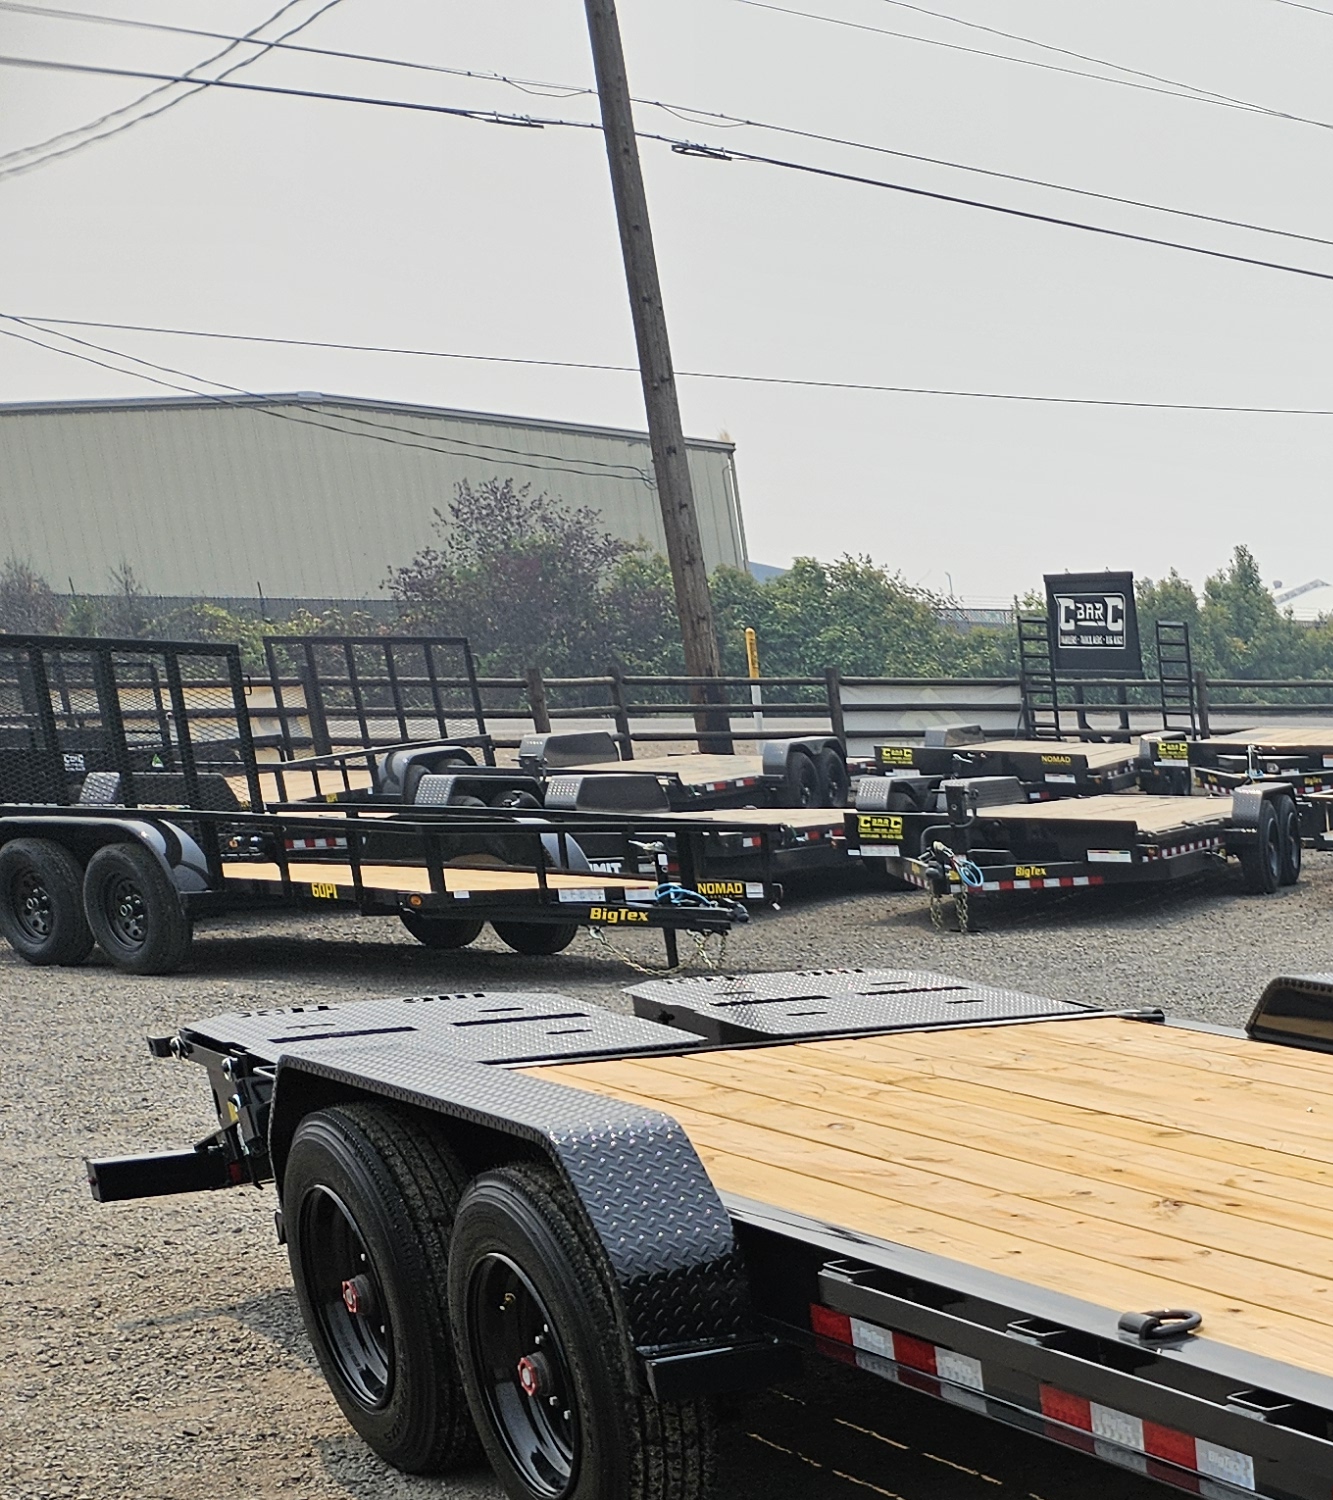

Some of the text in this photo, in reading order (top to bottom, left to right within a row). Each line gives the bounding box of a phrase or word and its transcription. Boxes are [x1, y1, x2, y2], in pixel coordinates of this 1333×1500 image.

[1057, 597, 1123, 631] C BAR C
[1041, 755, 1072, 763] NOMAD
[1015, 866, 1047, 878] BigTex
[311, 882, 338, 899] 60PI
[697, 882, 743, 894] NOMAD
[590, 907, 649, 923] BigTex
